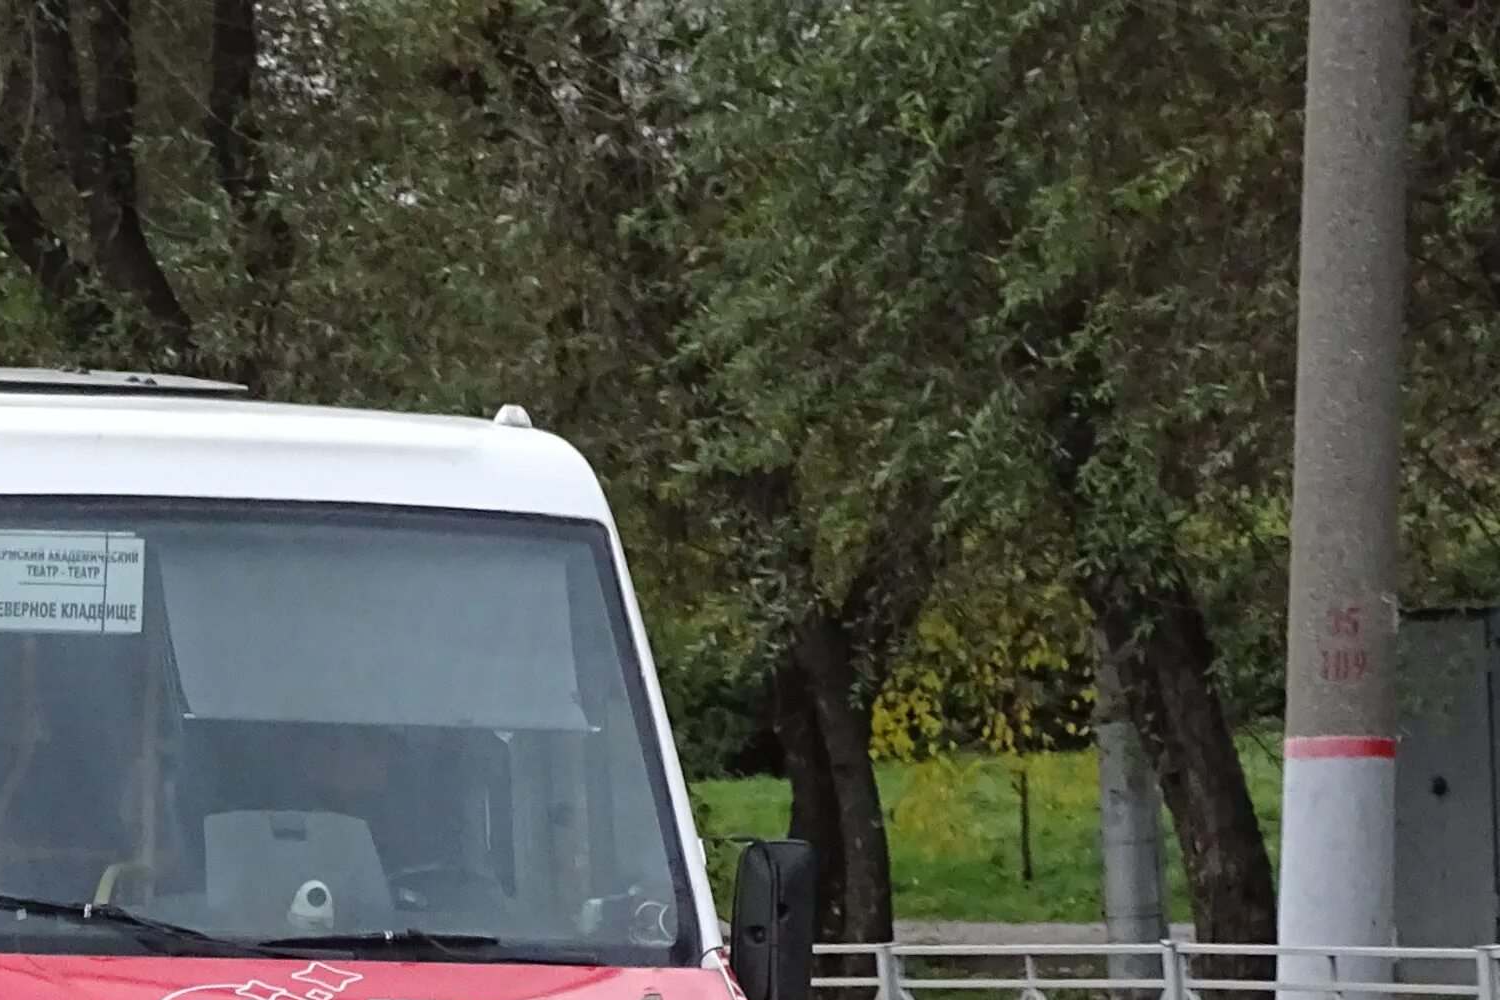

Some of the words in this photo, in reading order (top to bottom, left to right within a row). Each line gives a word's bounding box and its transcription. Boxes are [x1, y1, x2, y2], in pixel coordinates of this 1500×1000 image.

[47, 549, 139, 564] АКАДЕМИЧЕСКИЙ
[26, 564, 60, 577] ТЕАТР
[68, 565, 100, 579] ТЕАТР
[61, 603, 137, 622] КЛАДБИЩЕ
